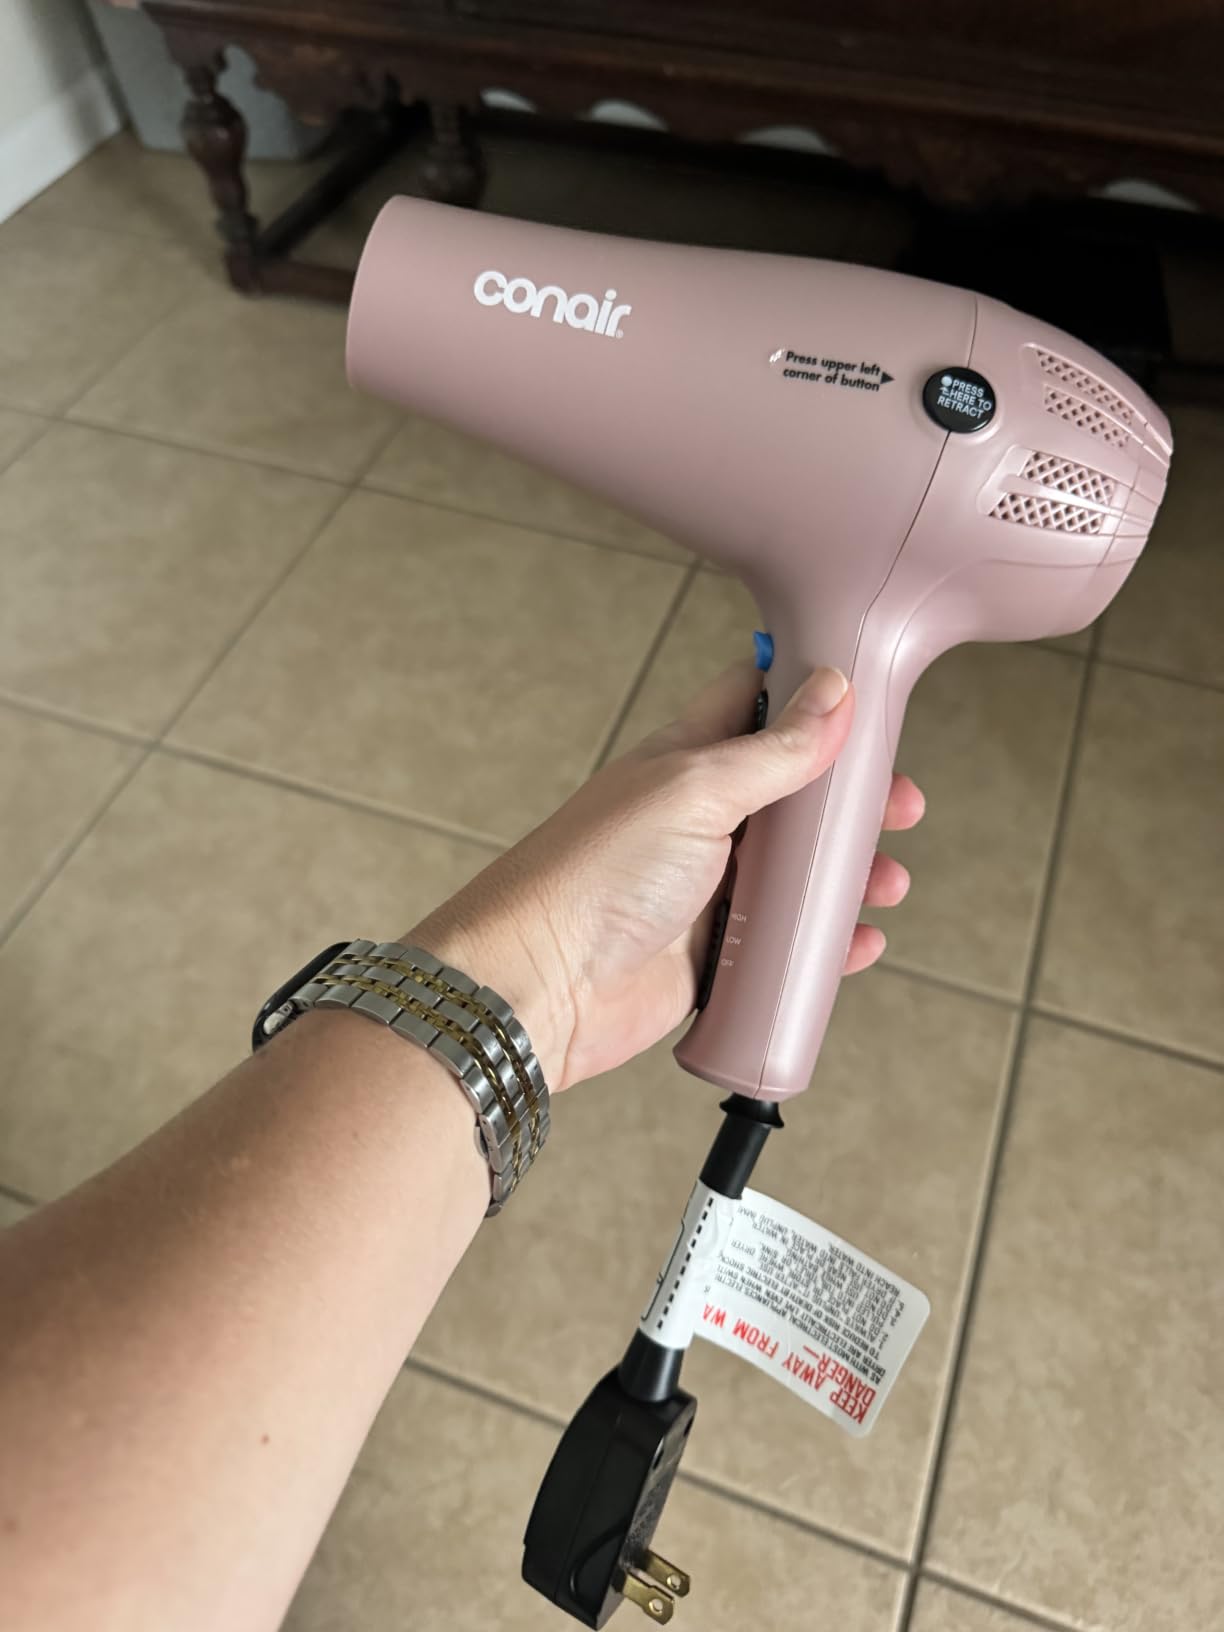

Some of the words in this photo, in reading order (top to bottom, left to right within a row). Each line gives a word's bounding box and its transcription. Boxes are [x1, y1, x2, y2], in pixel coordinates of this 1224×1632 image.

[473, 270, 632, 337] conair
[785, 351, 817, 366] Press
[821, 358, 857, 373] upper
[860, 362, 880, 376] left
[783, 368, 822, 382] corner
[825, 371, 839, 385] of
[840, 374, 880, 392] button
[952, 379, 984, 397] PRESS
[937, 395, 984, 419] RETRACT
[950, 389, 975, 406] HERE
[978, 399, 992, 411] TO
[731, 1318, 780, 1359] FROM
[782, 1351, 825, 1391] AWAY
[829, 1385, 868, 1424] KEEP
